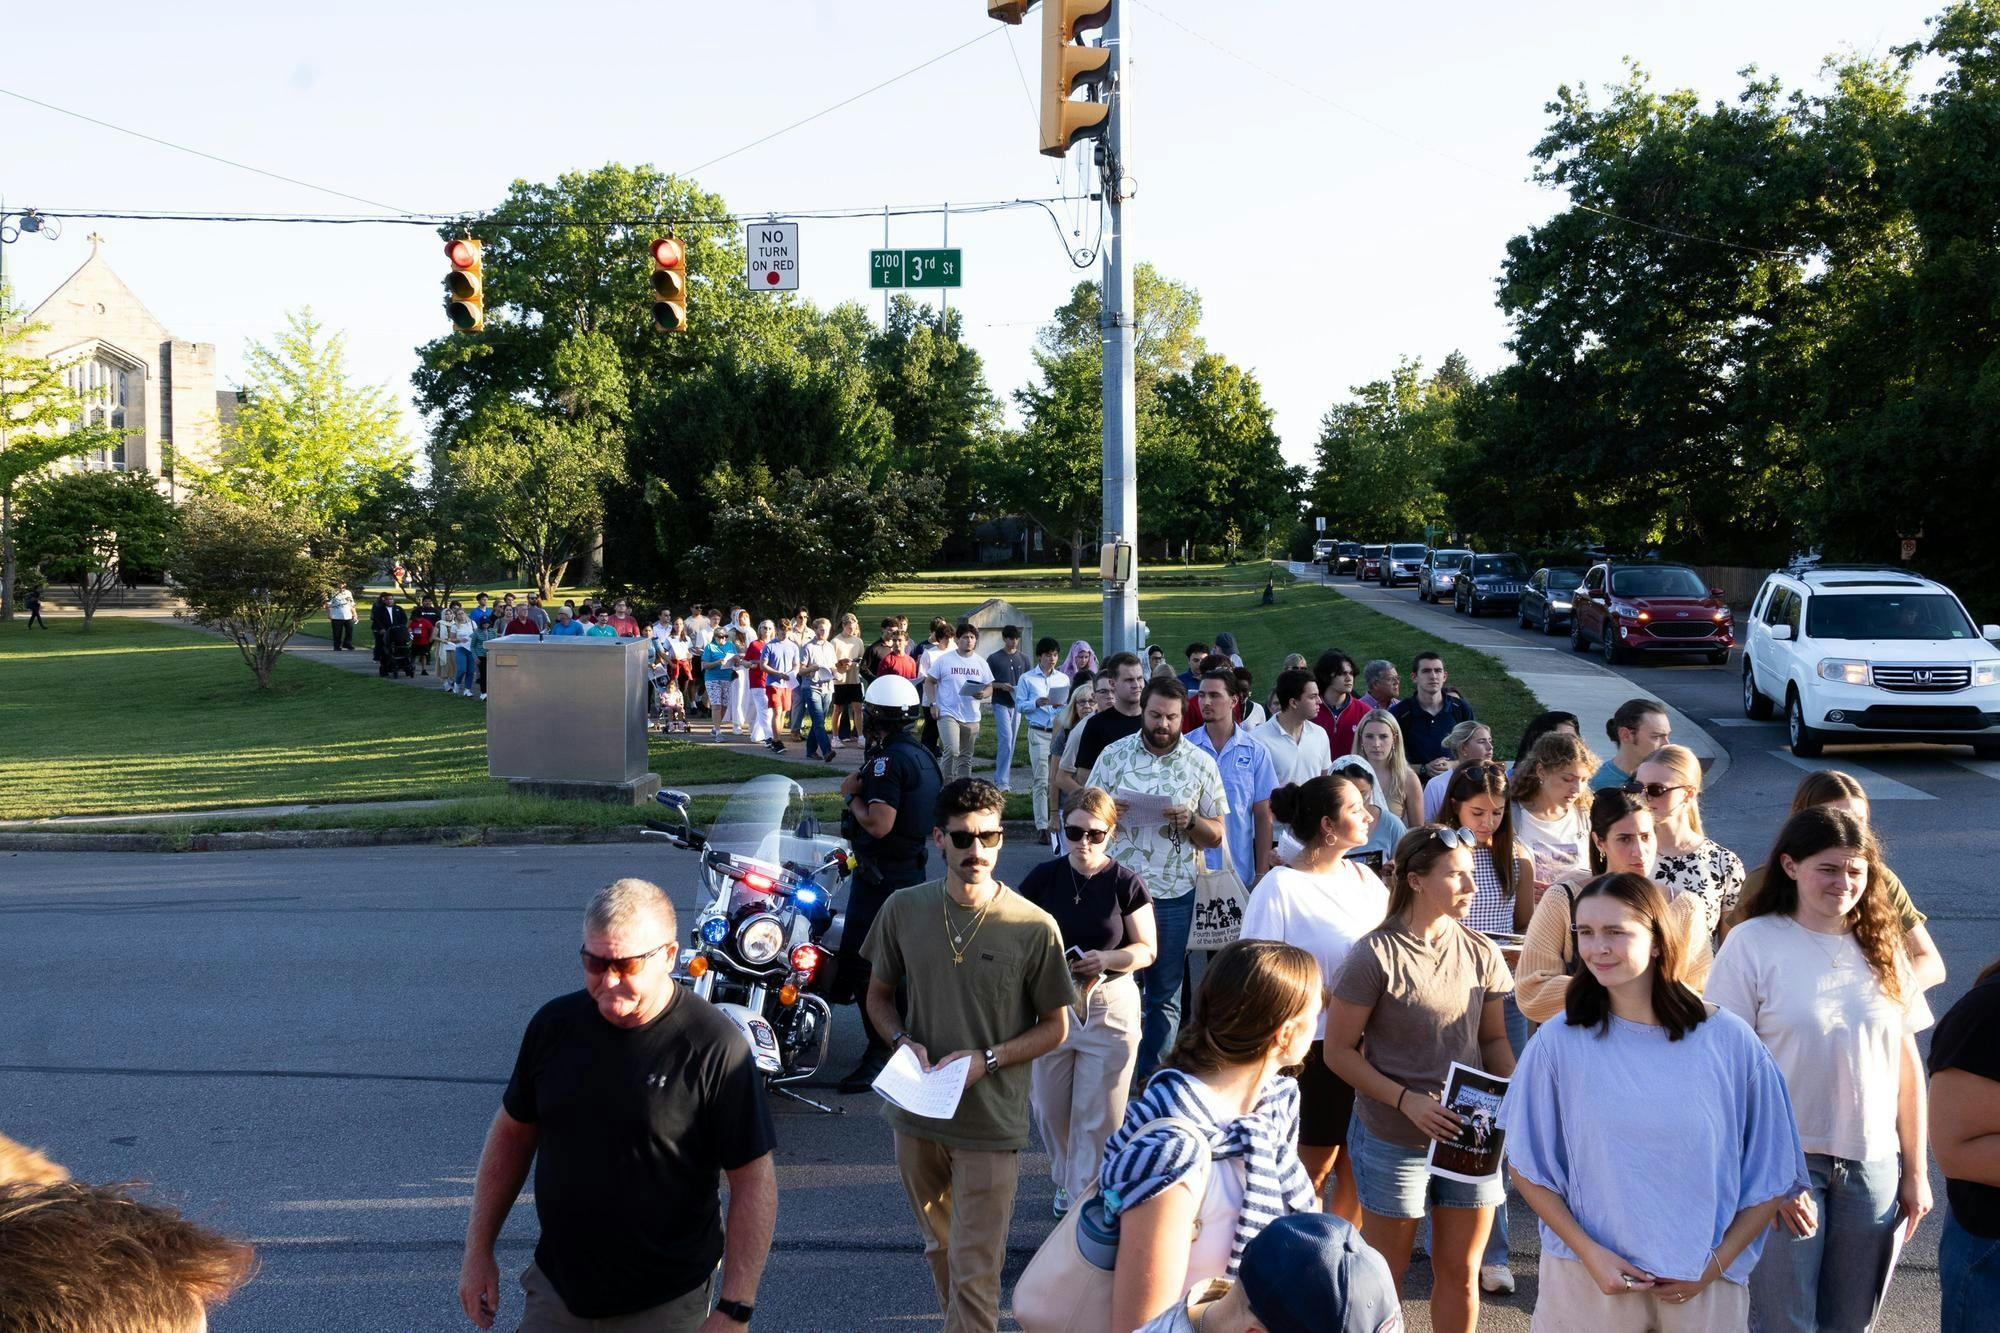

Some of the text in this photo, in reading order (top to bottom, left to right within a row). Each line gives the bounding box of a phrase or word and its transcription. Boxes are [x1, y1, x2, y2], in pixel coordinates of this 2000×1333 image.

[761, 230, 784, 244] NO
[758, 246, 788, 257] TURN
[752, 260, 794, 271] ON RED
[874, 254, 899, 268] 2100
[911, 256, 954, 281] 3rd St
[884, 271, 890, 284] E
[950, 667, 980, 676] INDIANA
[1193, 930, 1211, 938] Fourth
[1211, 929, 1226, 937] Street
